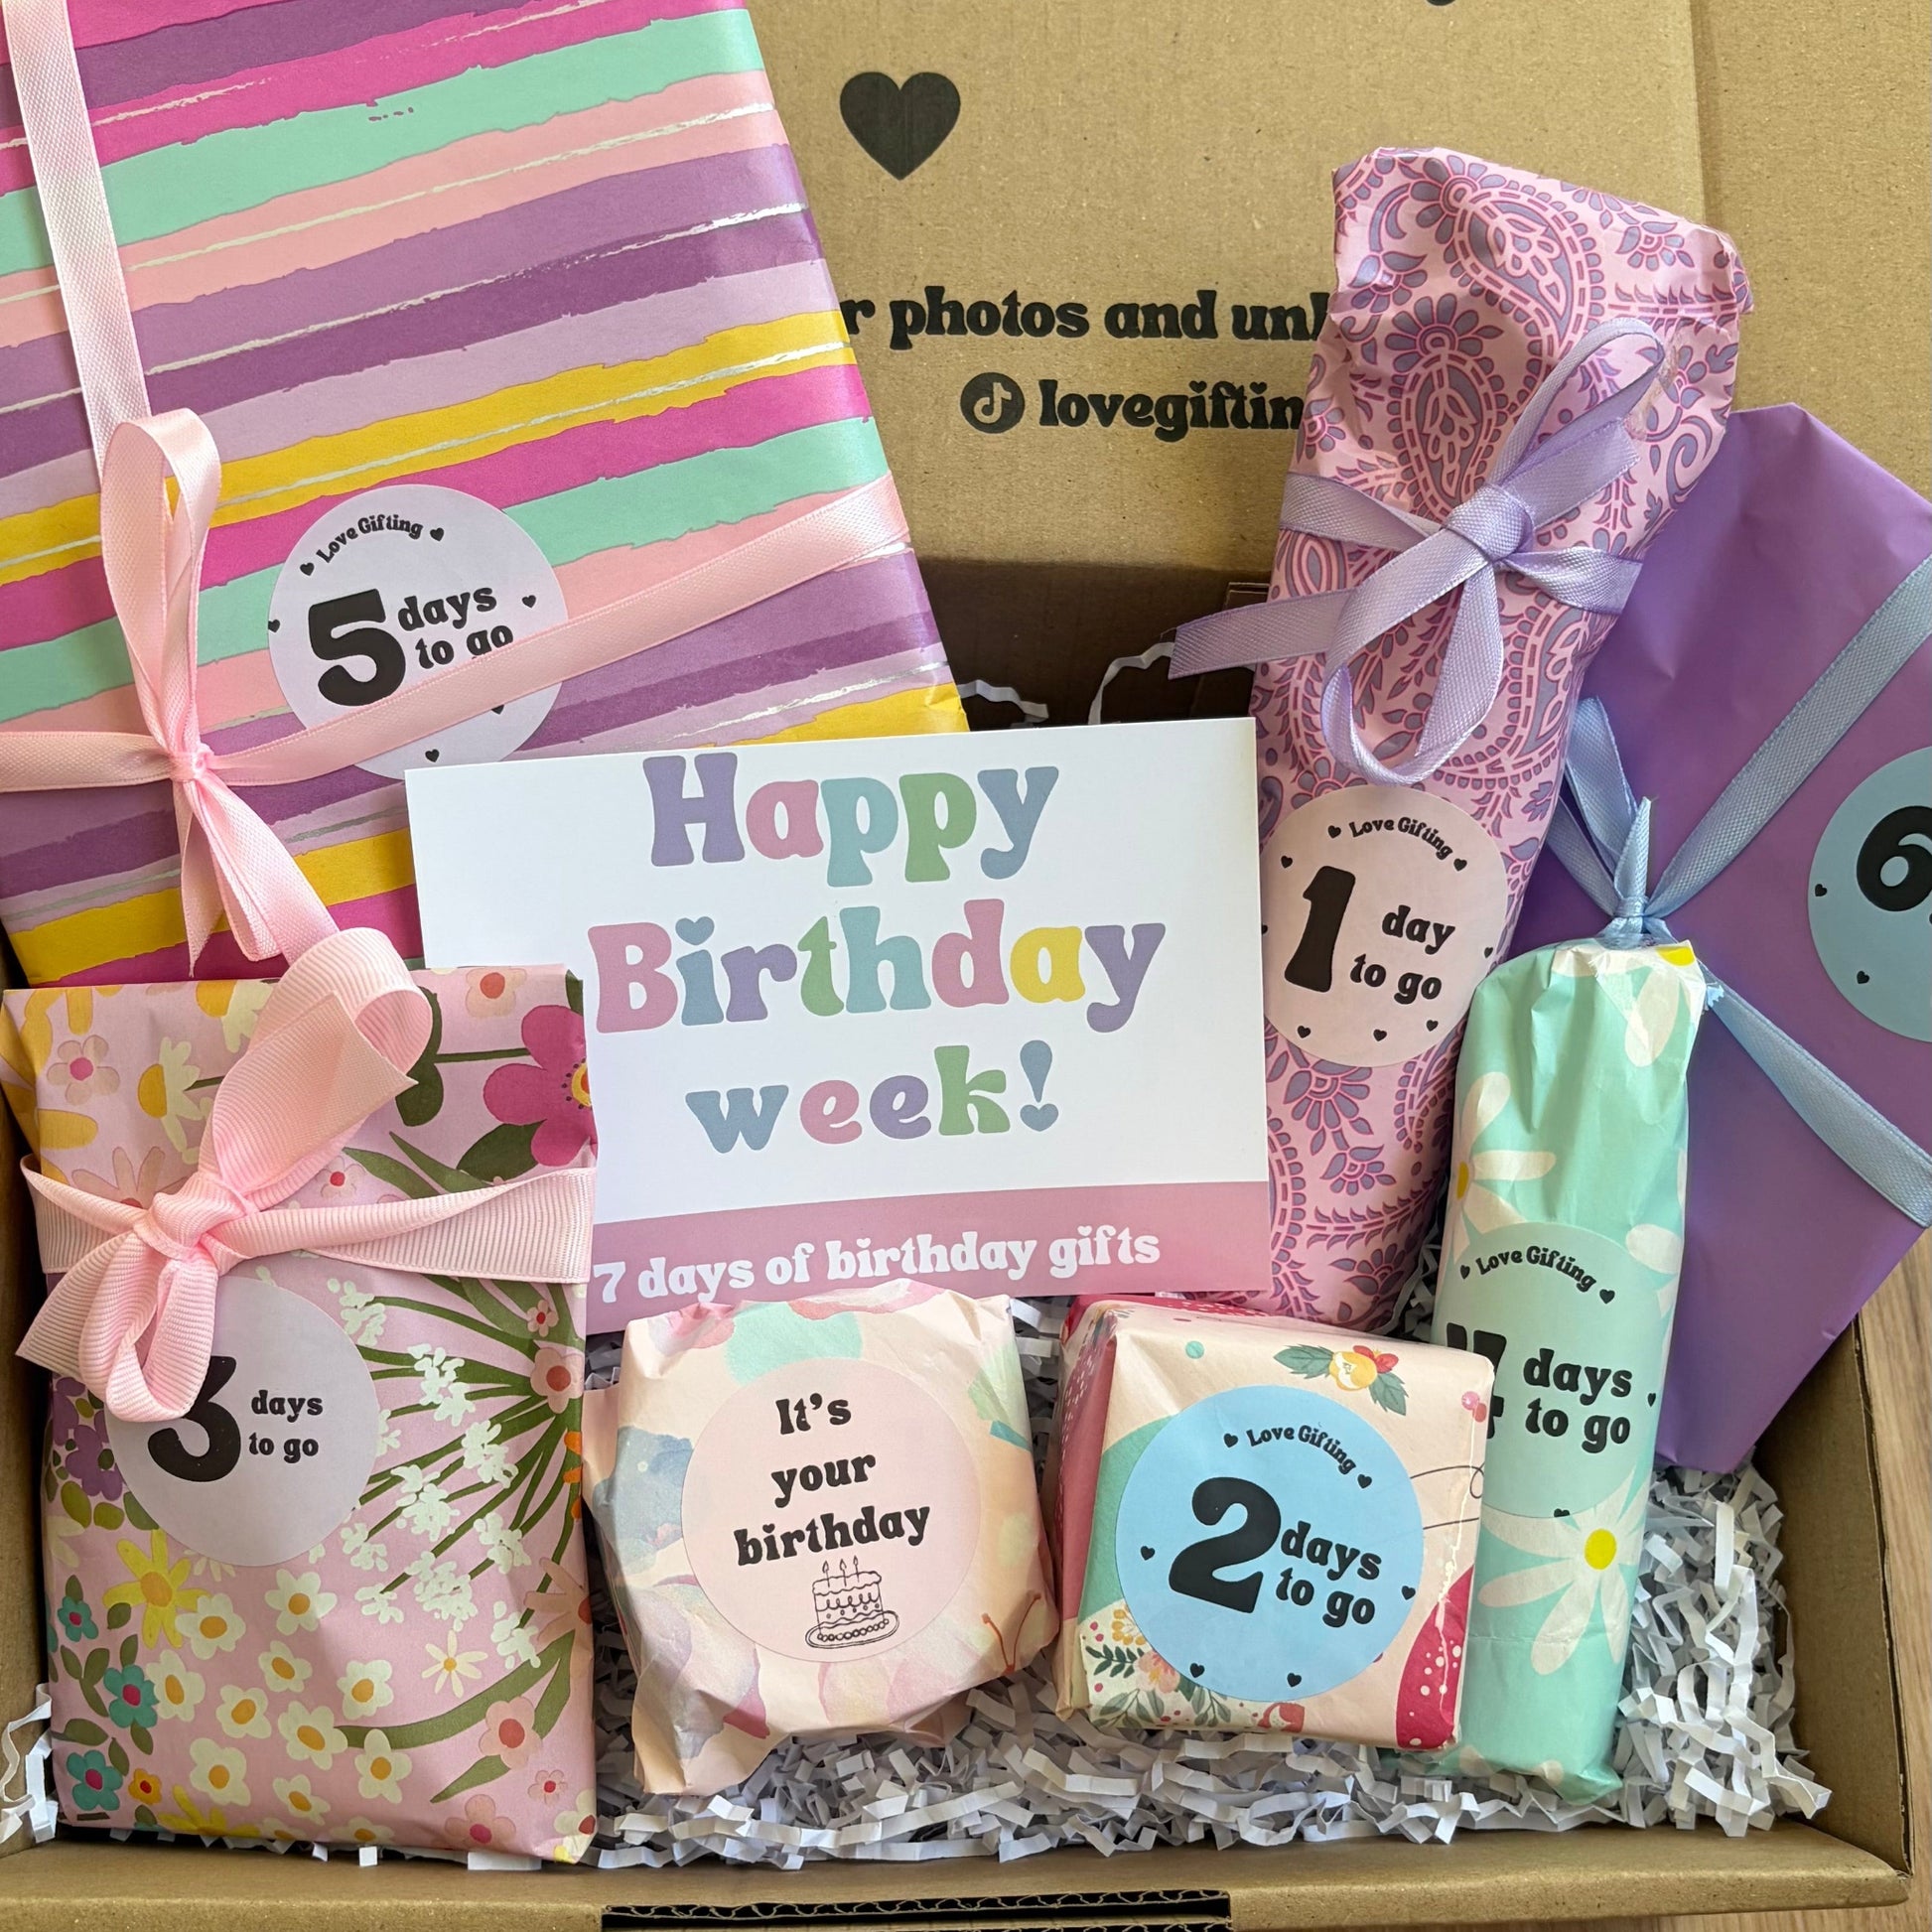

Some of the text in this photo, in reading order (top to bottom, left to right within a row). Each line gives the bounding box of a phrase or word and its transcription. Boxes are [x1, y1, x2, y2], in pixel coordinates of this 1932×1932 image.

[890, 285, 1089, 350] photos
[1104, 290, 1219, 340] and
[316, 513, 423, 564] Love Gifting
[308, 587, 497, 707] 5 days
[415, 637, 455, 670] to
[642, 752, 1059, 888] Happy
[1348, 817, 1453, 861] Love Gifting
[1284, 866, 1455, 993] 1 day
[587, 898, 1167, 1034] Birthday
[1350, 954, 1442, 1005] to go
[685, 1039, 1059, 1154] week!
[593, 1225, 1161, 1304] 7 days of birthday gifts
[1475, 1245, 1596, 1293] Love Gifting
[1523, 1348, 1632, 1406] days
[147, 1356, 324, 1483] 3 days
[775, 1392, 852, 1435] It's
[1525, 1398, 1630, 1453] to go
[248, 1433, 319, 1463] to go
[1246, 1425, 1356, 1475] Love Gifting
[770, 1454, 876, 1508] your
[734, 1505, 930, 1567] birthday
[1169, 1476, 1382, 1614] 2 days
[1276, 1568, 1376, 1628] to go
